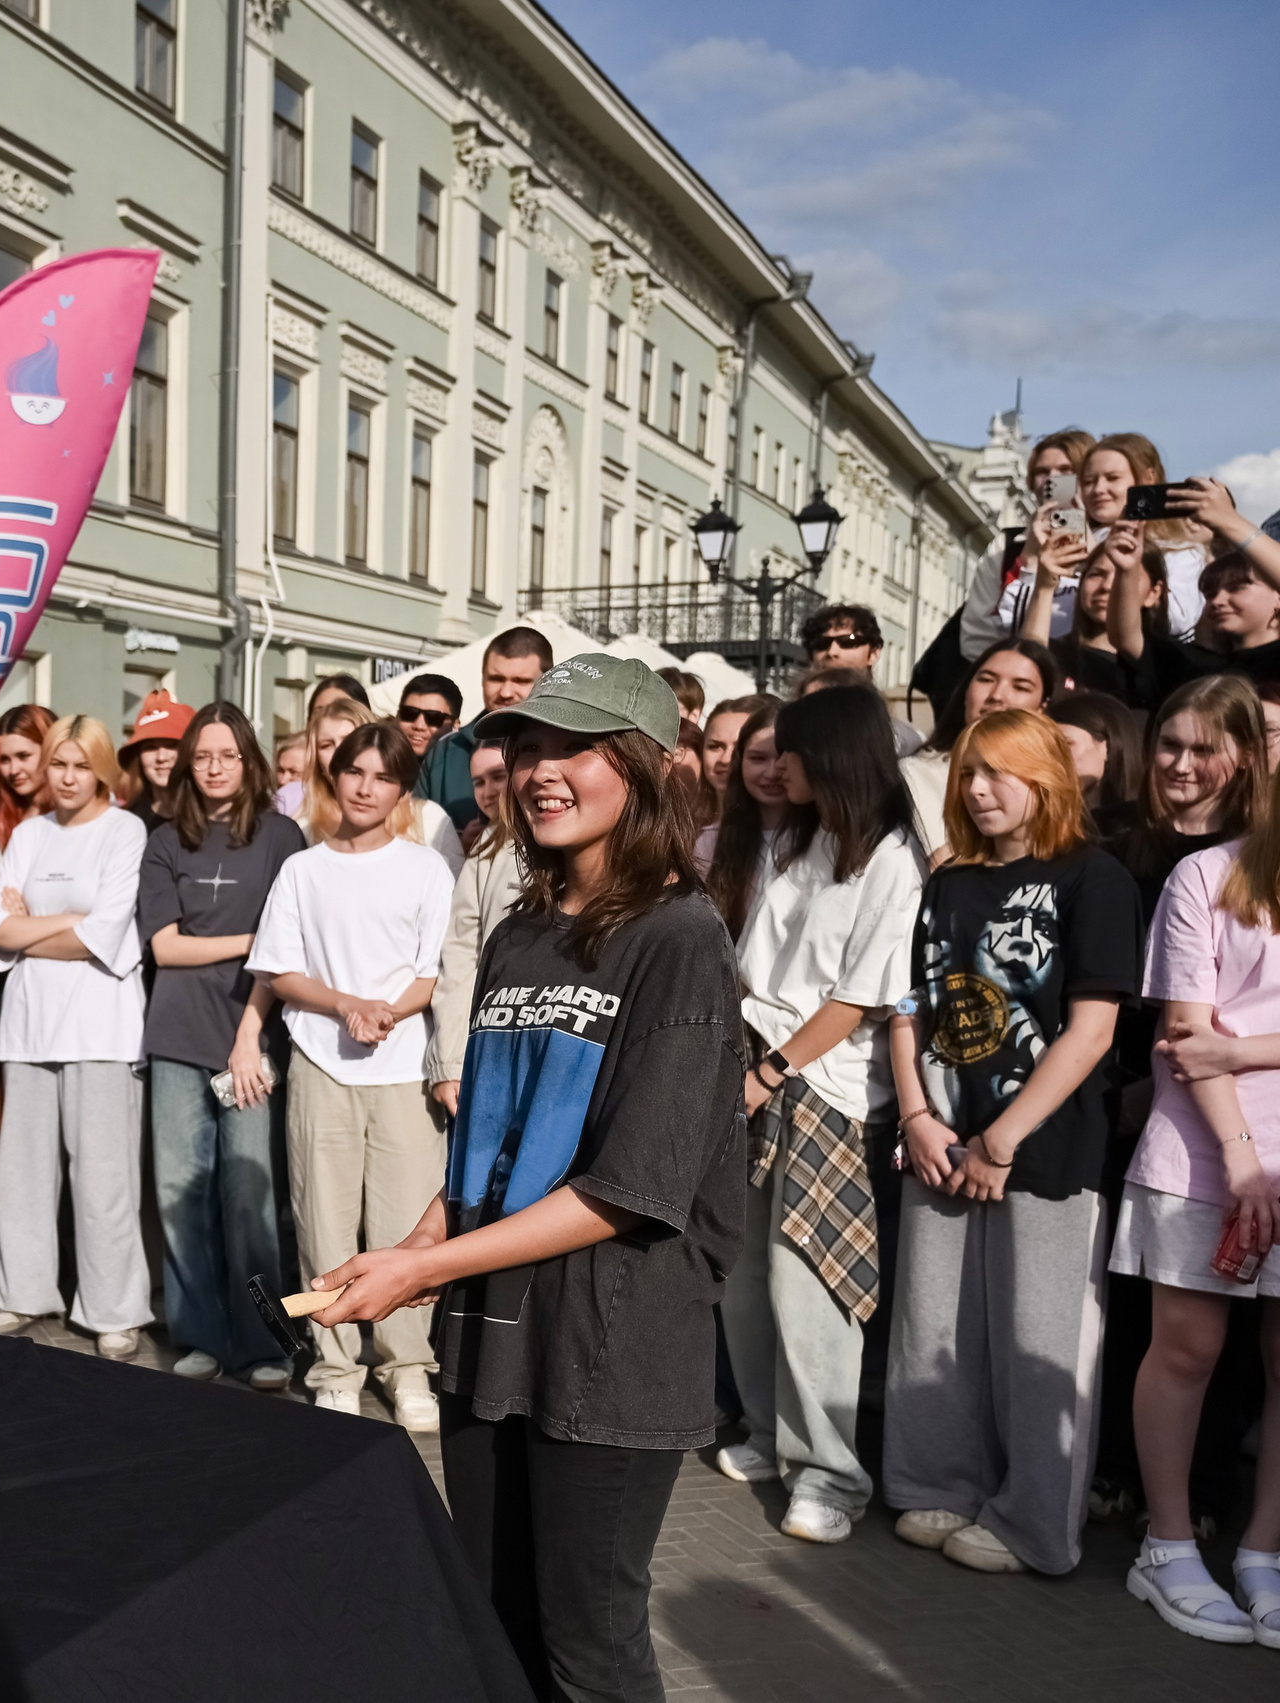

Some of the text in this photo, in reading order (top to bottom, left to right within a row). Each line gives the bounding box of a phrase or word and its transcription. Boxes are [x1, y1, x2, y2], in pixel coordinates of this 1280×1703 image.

[491, 986, 536, 1006] ME
[535, 985, 621, 1018] HARD
[516, 1004, 598, 1034] SOFT
